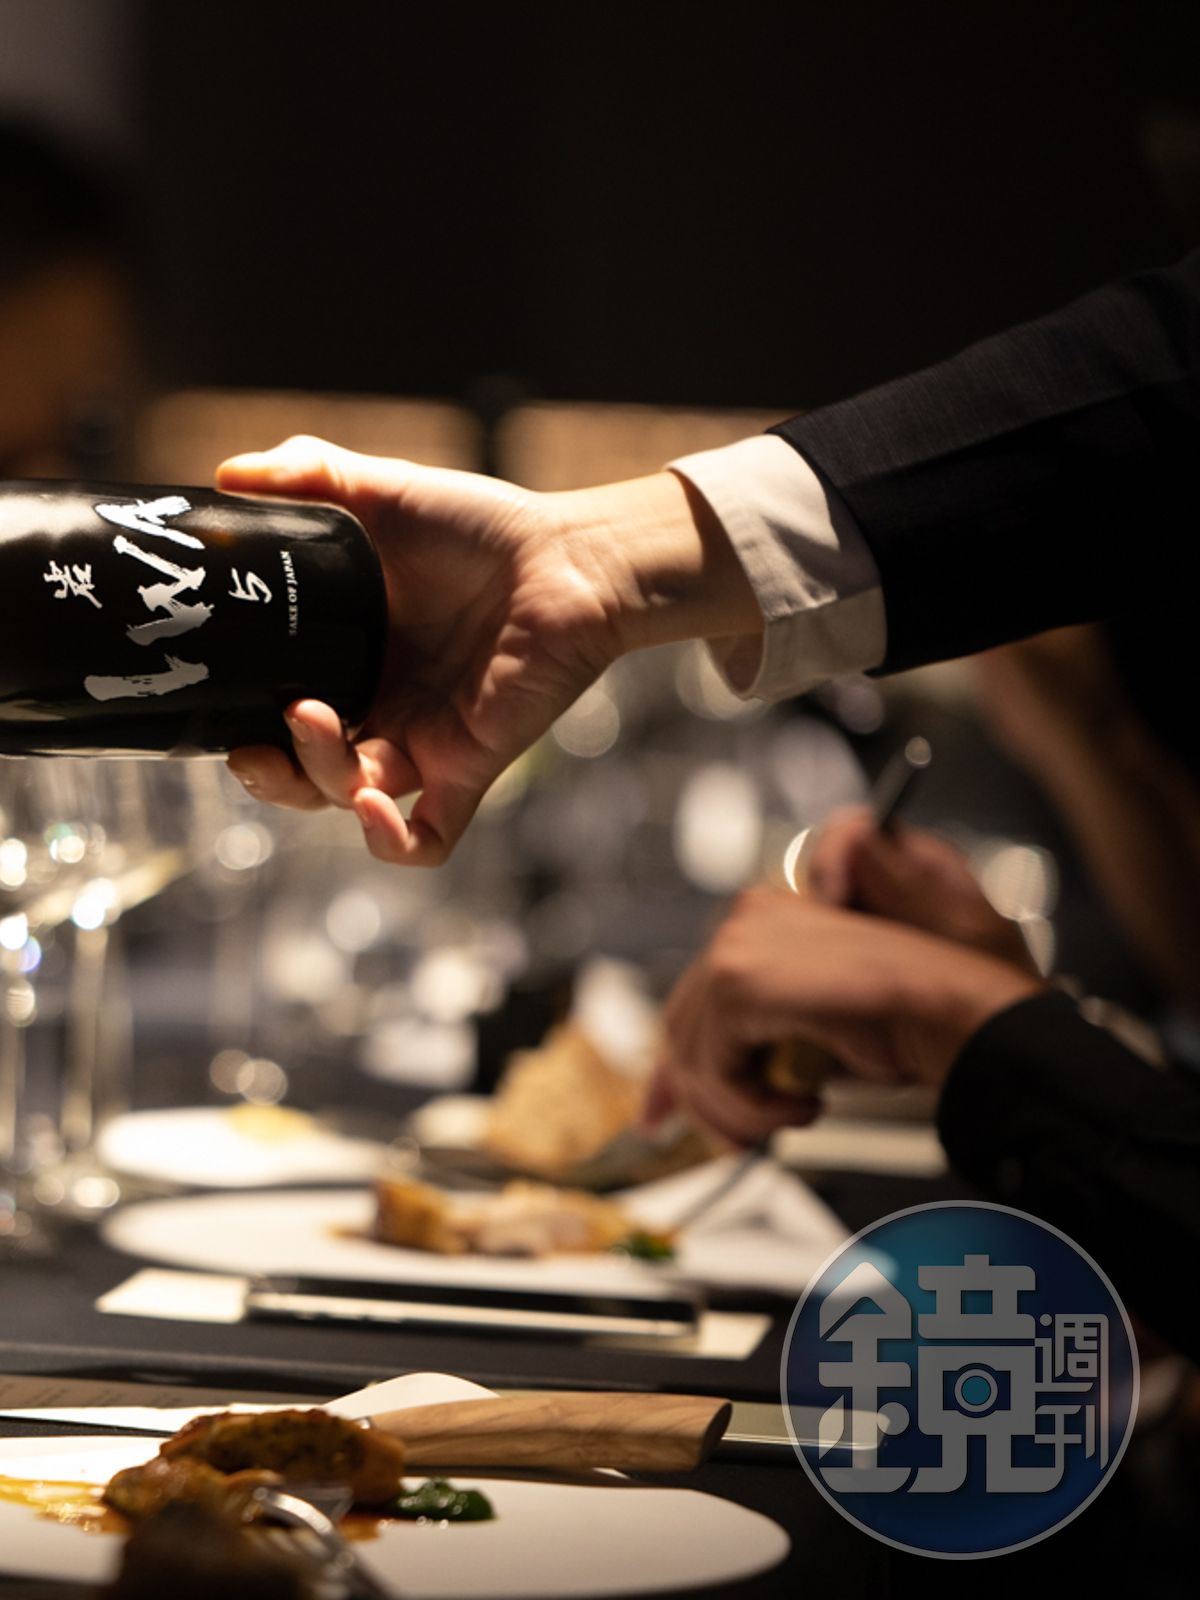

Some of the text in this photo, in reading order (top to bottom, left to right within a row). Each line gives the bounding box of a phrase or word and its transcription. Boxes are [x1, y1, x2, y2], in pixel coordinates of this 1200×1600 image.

[43, 560, 102, 608] 岩
[84, 496, 214, 701] IWA
[229, 568, 272, 604] 5
[280, 550, 298, 637] SAKE OF JAPAN
